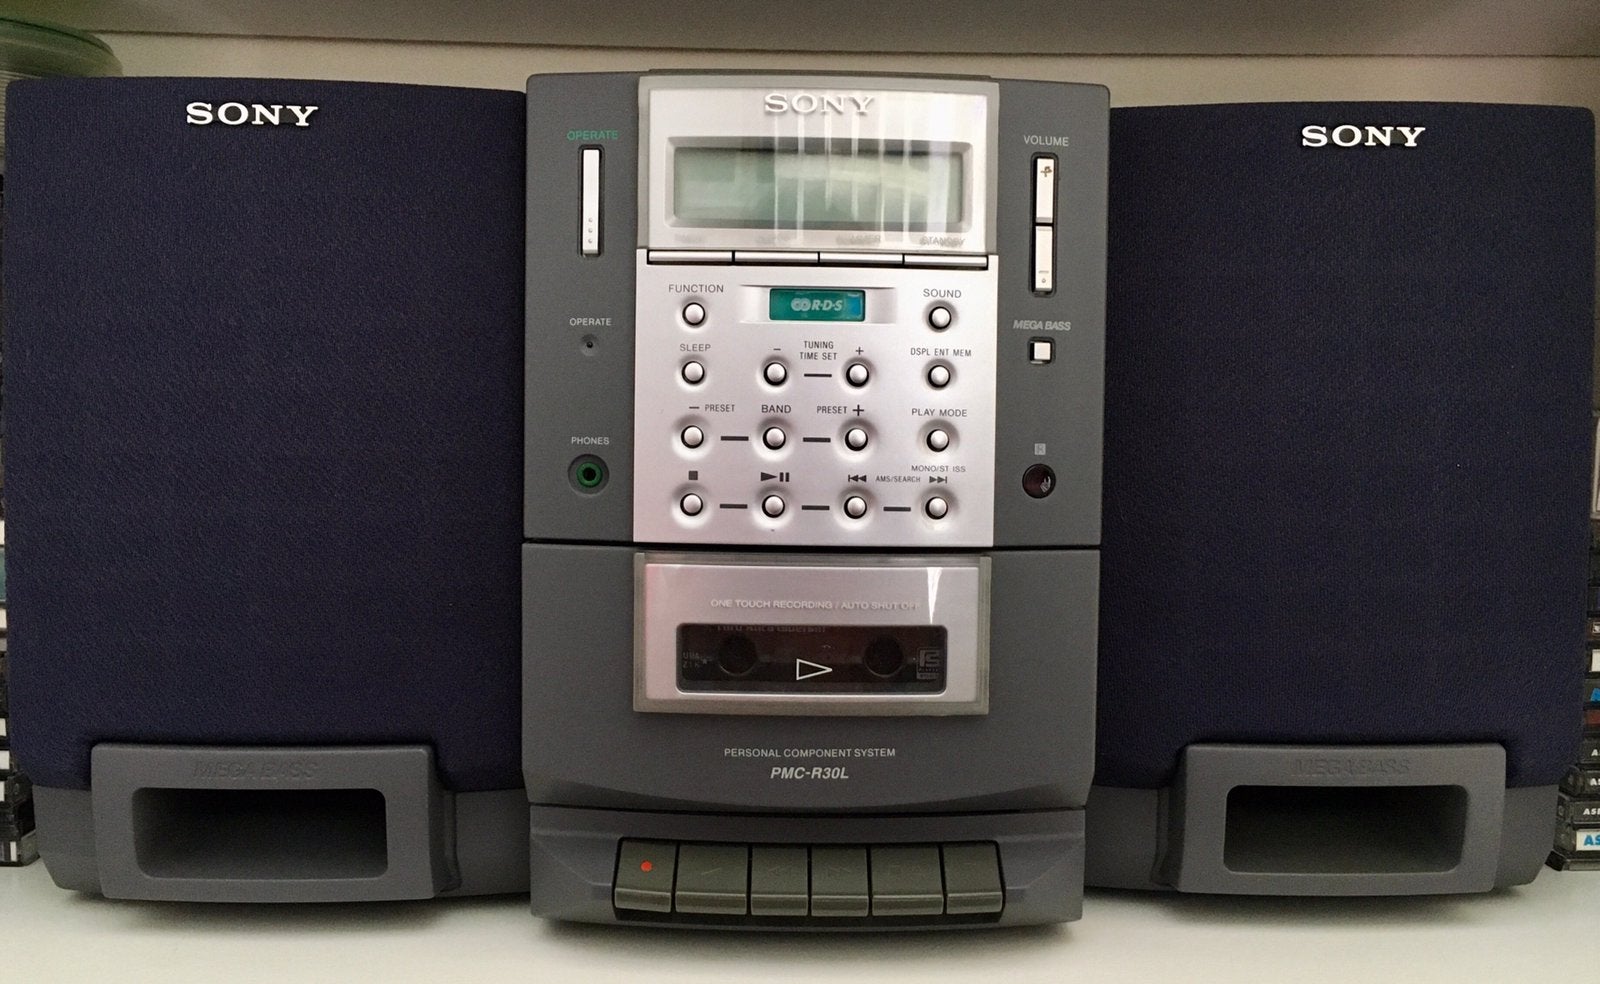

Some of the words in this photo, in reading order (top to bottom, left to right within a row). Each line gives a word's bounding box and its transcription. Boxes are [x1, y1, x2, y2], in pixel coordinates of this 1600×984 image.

[764, 93, 874, 114] SONY
[186, 101, 319, 127] SONY
[566, 130, 619, 141] OPERATE
[1301, 124, 1426, 148] SONY
[1023, 135, 1069, 147] VOLUME
[919, 236, 966, 247] STANDBY
[668, 284, 724, 294] FUNCTION
[922, 288, 962, 299] SOUND
[569, 317, 612, 327] OPERATE
[1012, 319, 1043, 330] MEGA
[1044, 320, 1072, 331] BASS
[679, 343, 711, 353] SLEEP
[803, 340, 834, 350] TUNING
[799, 351, 819, 361] TIME
[821, 352, 838, 361] SET
[910, 347, 932, 357] DSPL
[934, 347, 951, 357] ENT
[953, 348, 972, 358] MEM
[704, 403, 736, 413] PRESET
[761, 404, 792, 415] BAND
[816, 405, 848, 415] PRESET
[911, 408, 936, 418] PLAY
[939, 408, 968, 418] MODE
[571, 436, 610, 446] PHONES
[911, 464, 949, 474] MONO/ST
[952, 465, 966, 474] ISS
[875, 475, 921, 484] AMS/SEARCH
[710, 598, 733, 609] ONE
[735, 599, 771, 609] TOUCH
[773, 600, 833, 610] RECORDING
[841, 601, 870, 611] AUTO
[871, 601, 899, 611] SHUT
[724, 748, 781, 758] PERSONAL
[783, 748, 852, 758] COMPONENT
[854, 748, 896, 757] SYSTEM
[770, 767, 849, 780] PMC-R30L
